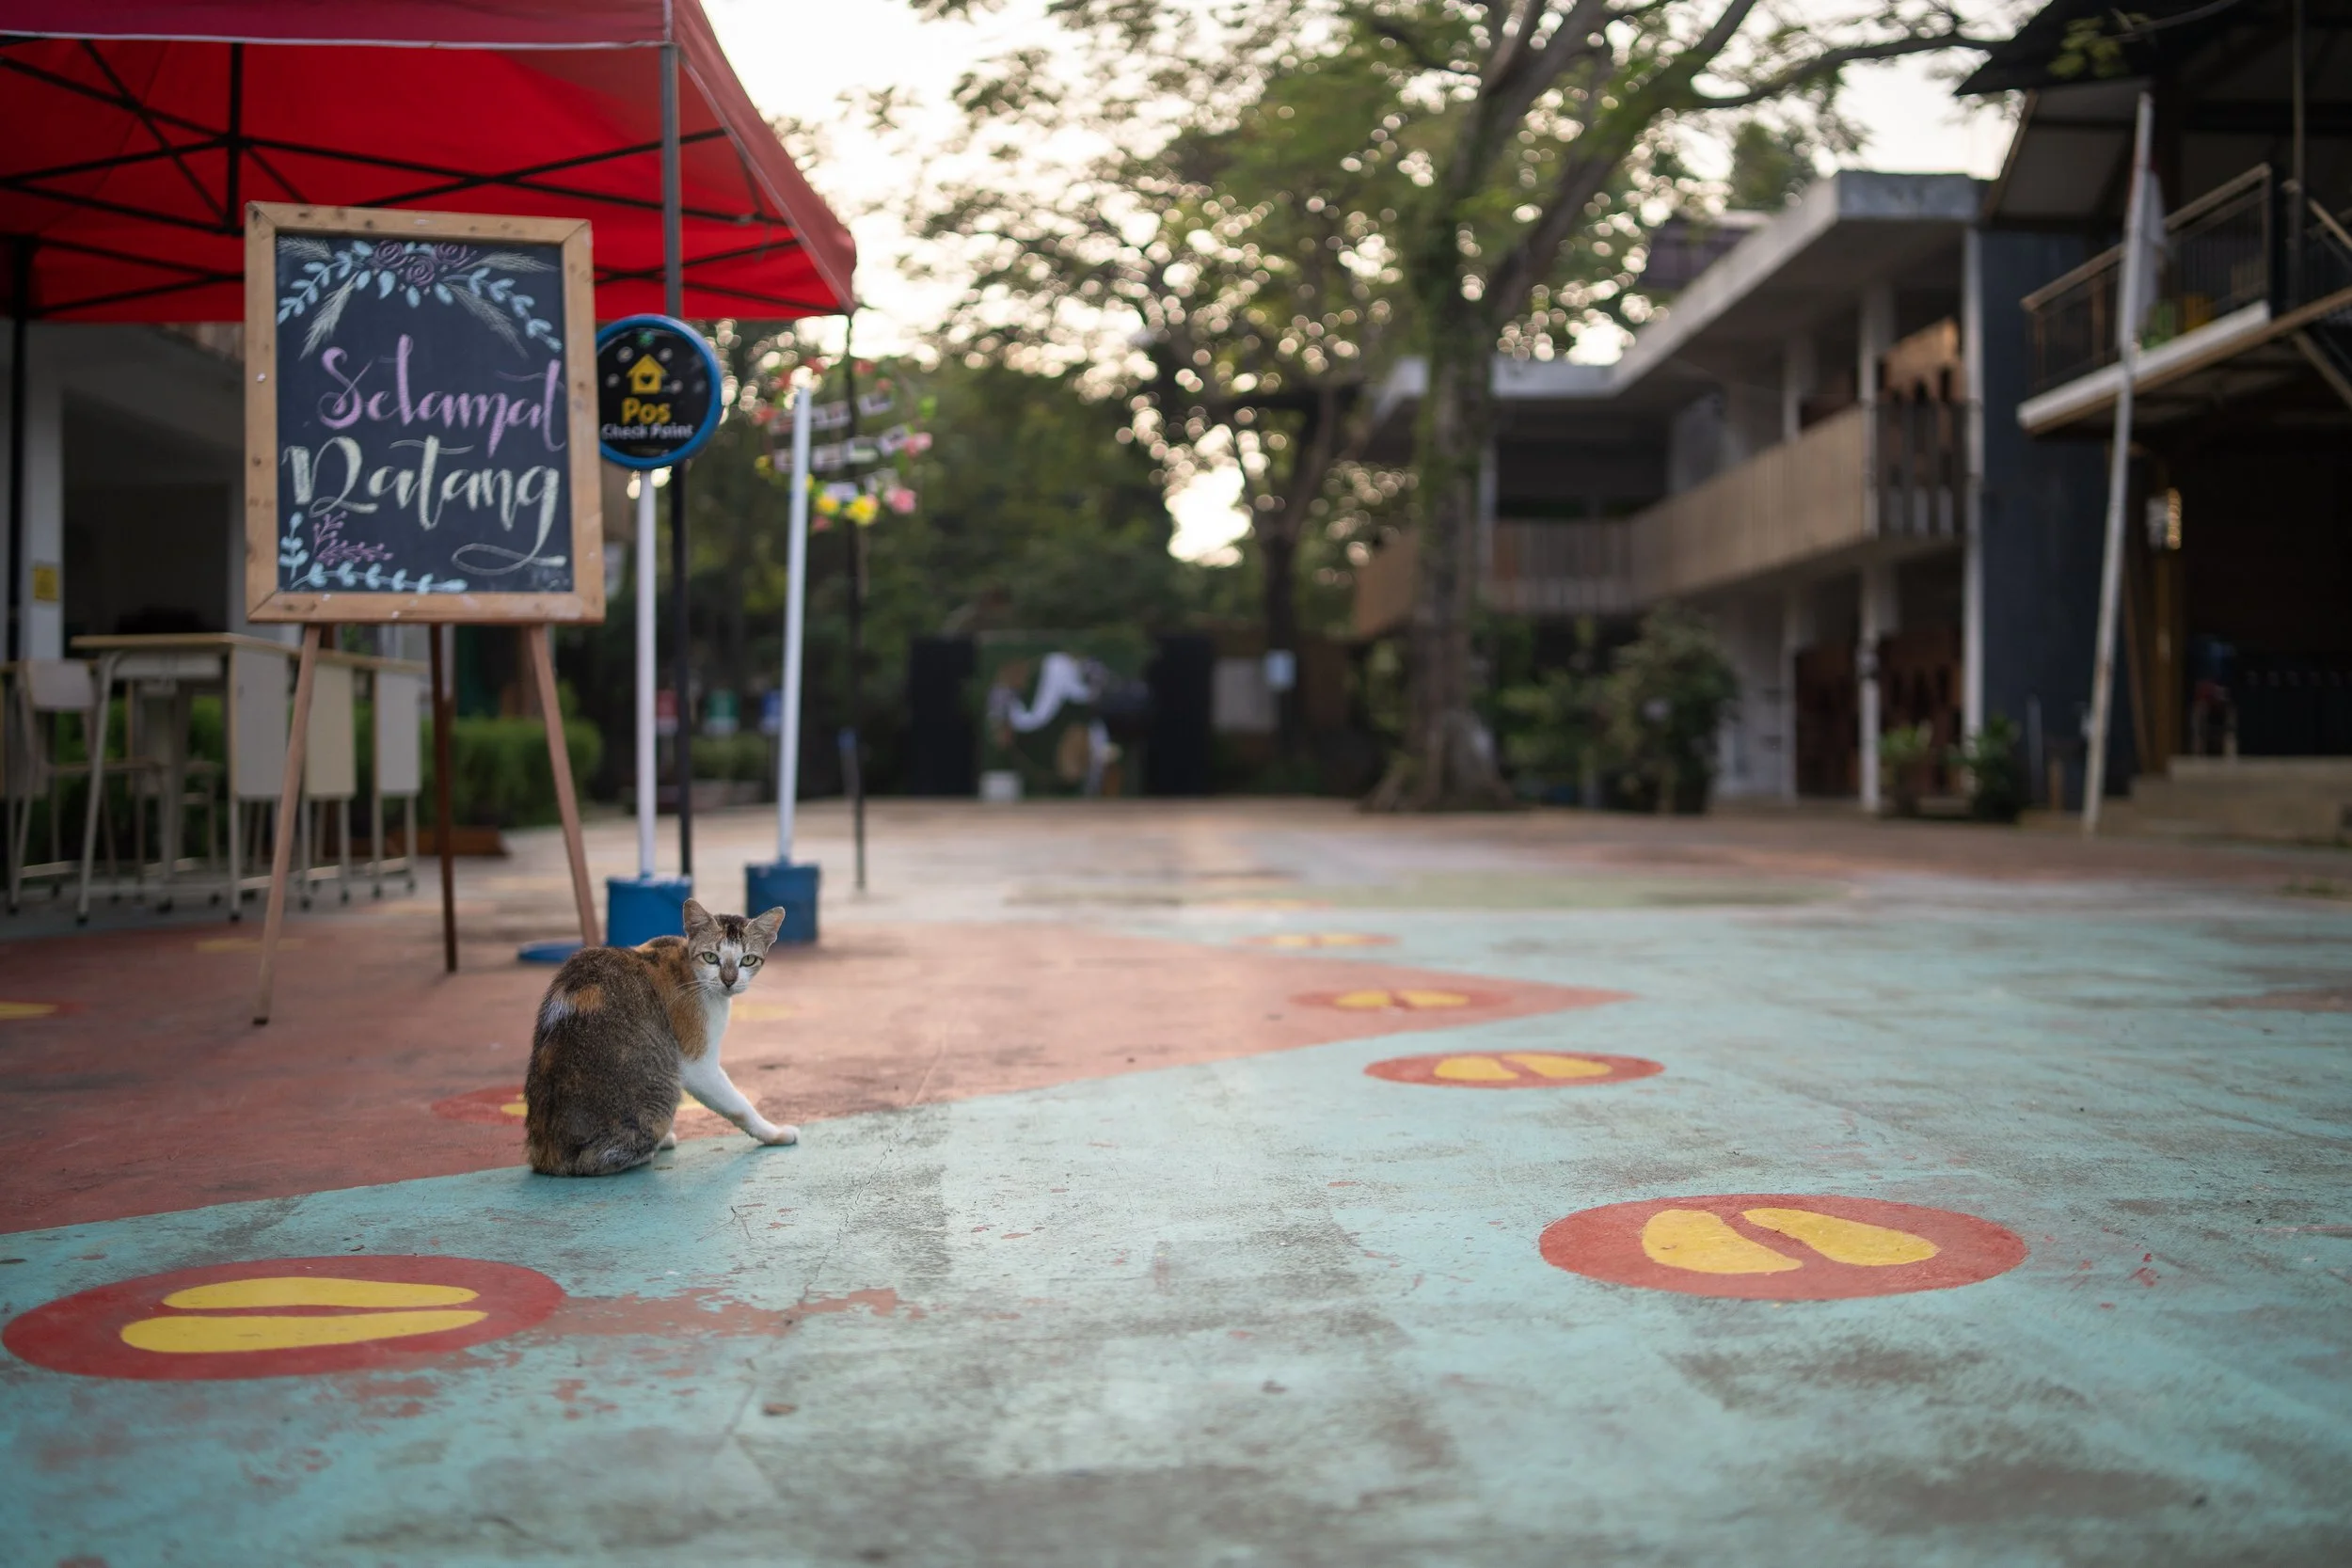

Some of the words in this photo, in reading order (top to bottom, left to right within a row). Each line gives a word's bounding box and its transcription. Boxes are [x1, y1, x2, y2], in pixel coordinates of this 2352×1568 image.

[317, 334, 565, 458] Selamat
[600, 423, 647, 439] Check
[652, 422, 693, 438] Point
[622, 397, 672, 423] Pos
[281, 435, 566, 576] Datang
